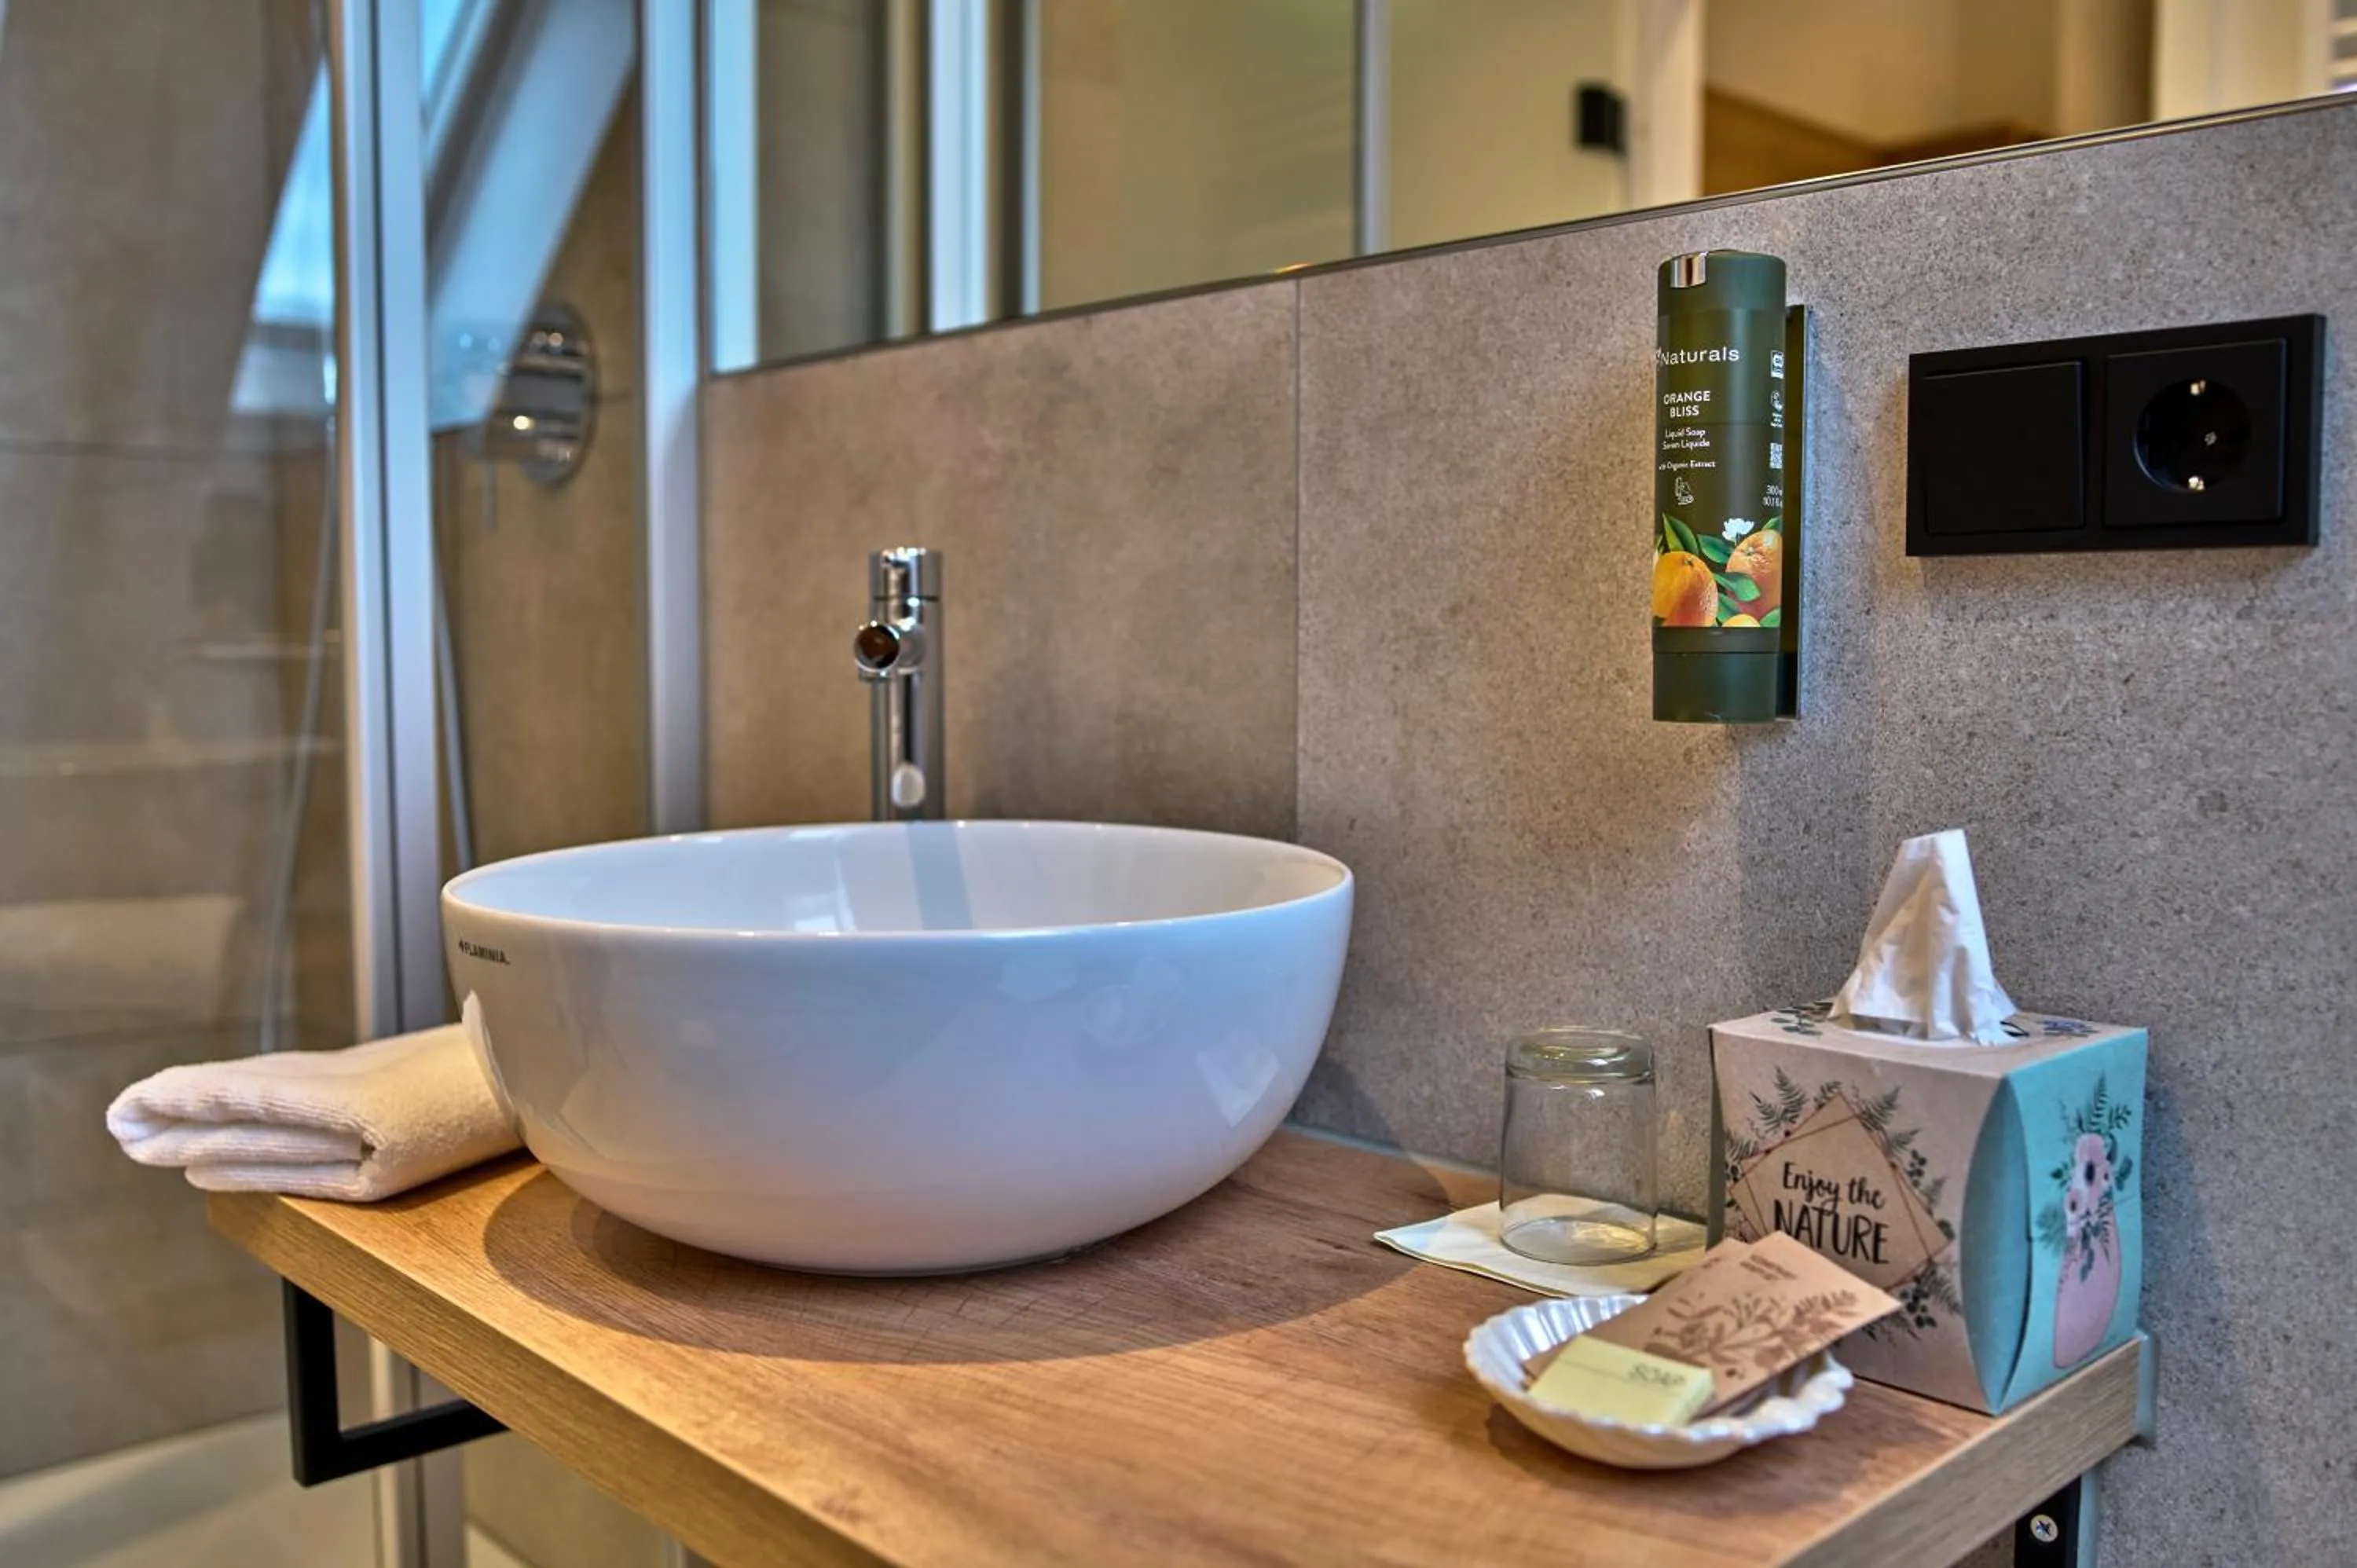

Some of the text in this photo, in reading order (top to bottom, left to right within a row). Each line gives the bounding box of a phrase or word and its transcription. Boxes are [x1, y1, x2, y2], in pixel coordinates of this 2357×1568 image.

[1661, 346, 1740, 365] Naturals
[1663, 390, 1711, 405] ORANGE
[1670, 405, 1700, 418] BLISS
[1685, 427, 1706, 438] Soap
[1690, 460, 1716, 470] Extract
[1782, 1161, 1885, 1216] Enjoy the
[1773, 1199, 1890, 1265] NATURE
